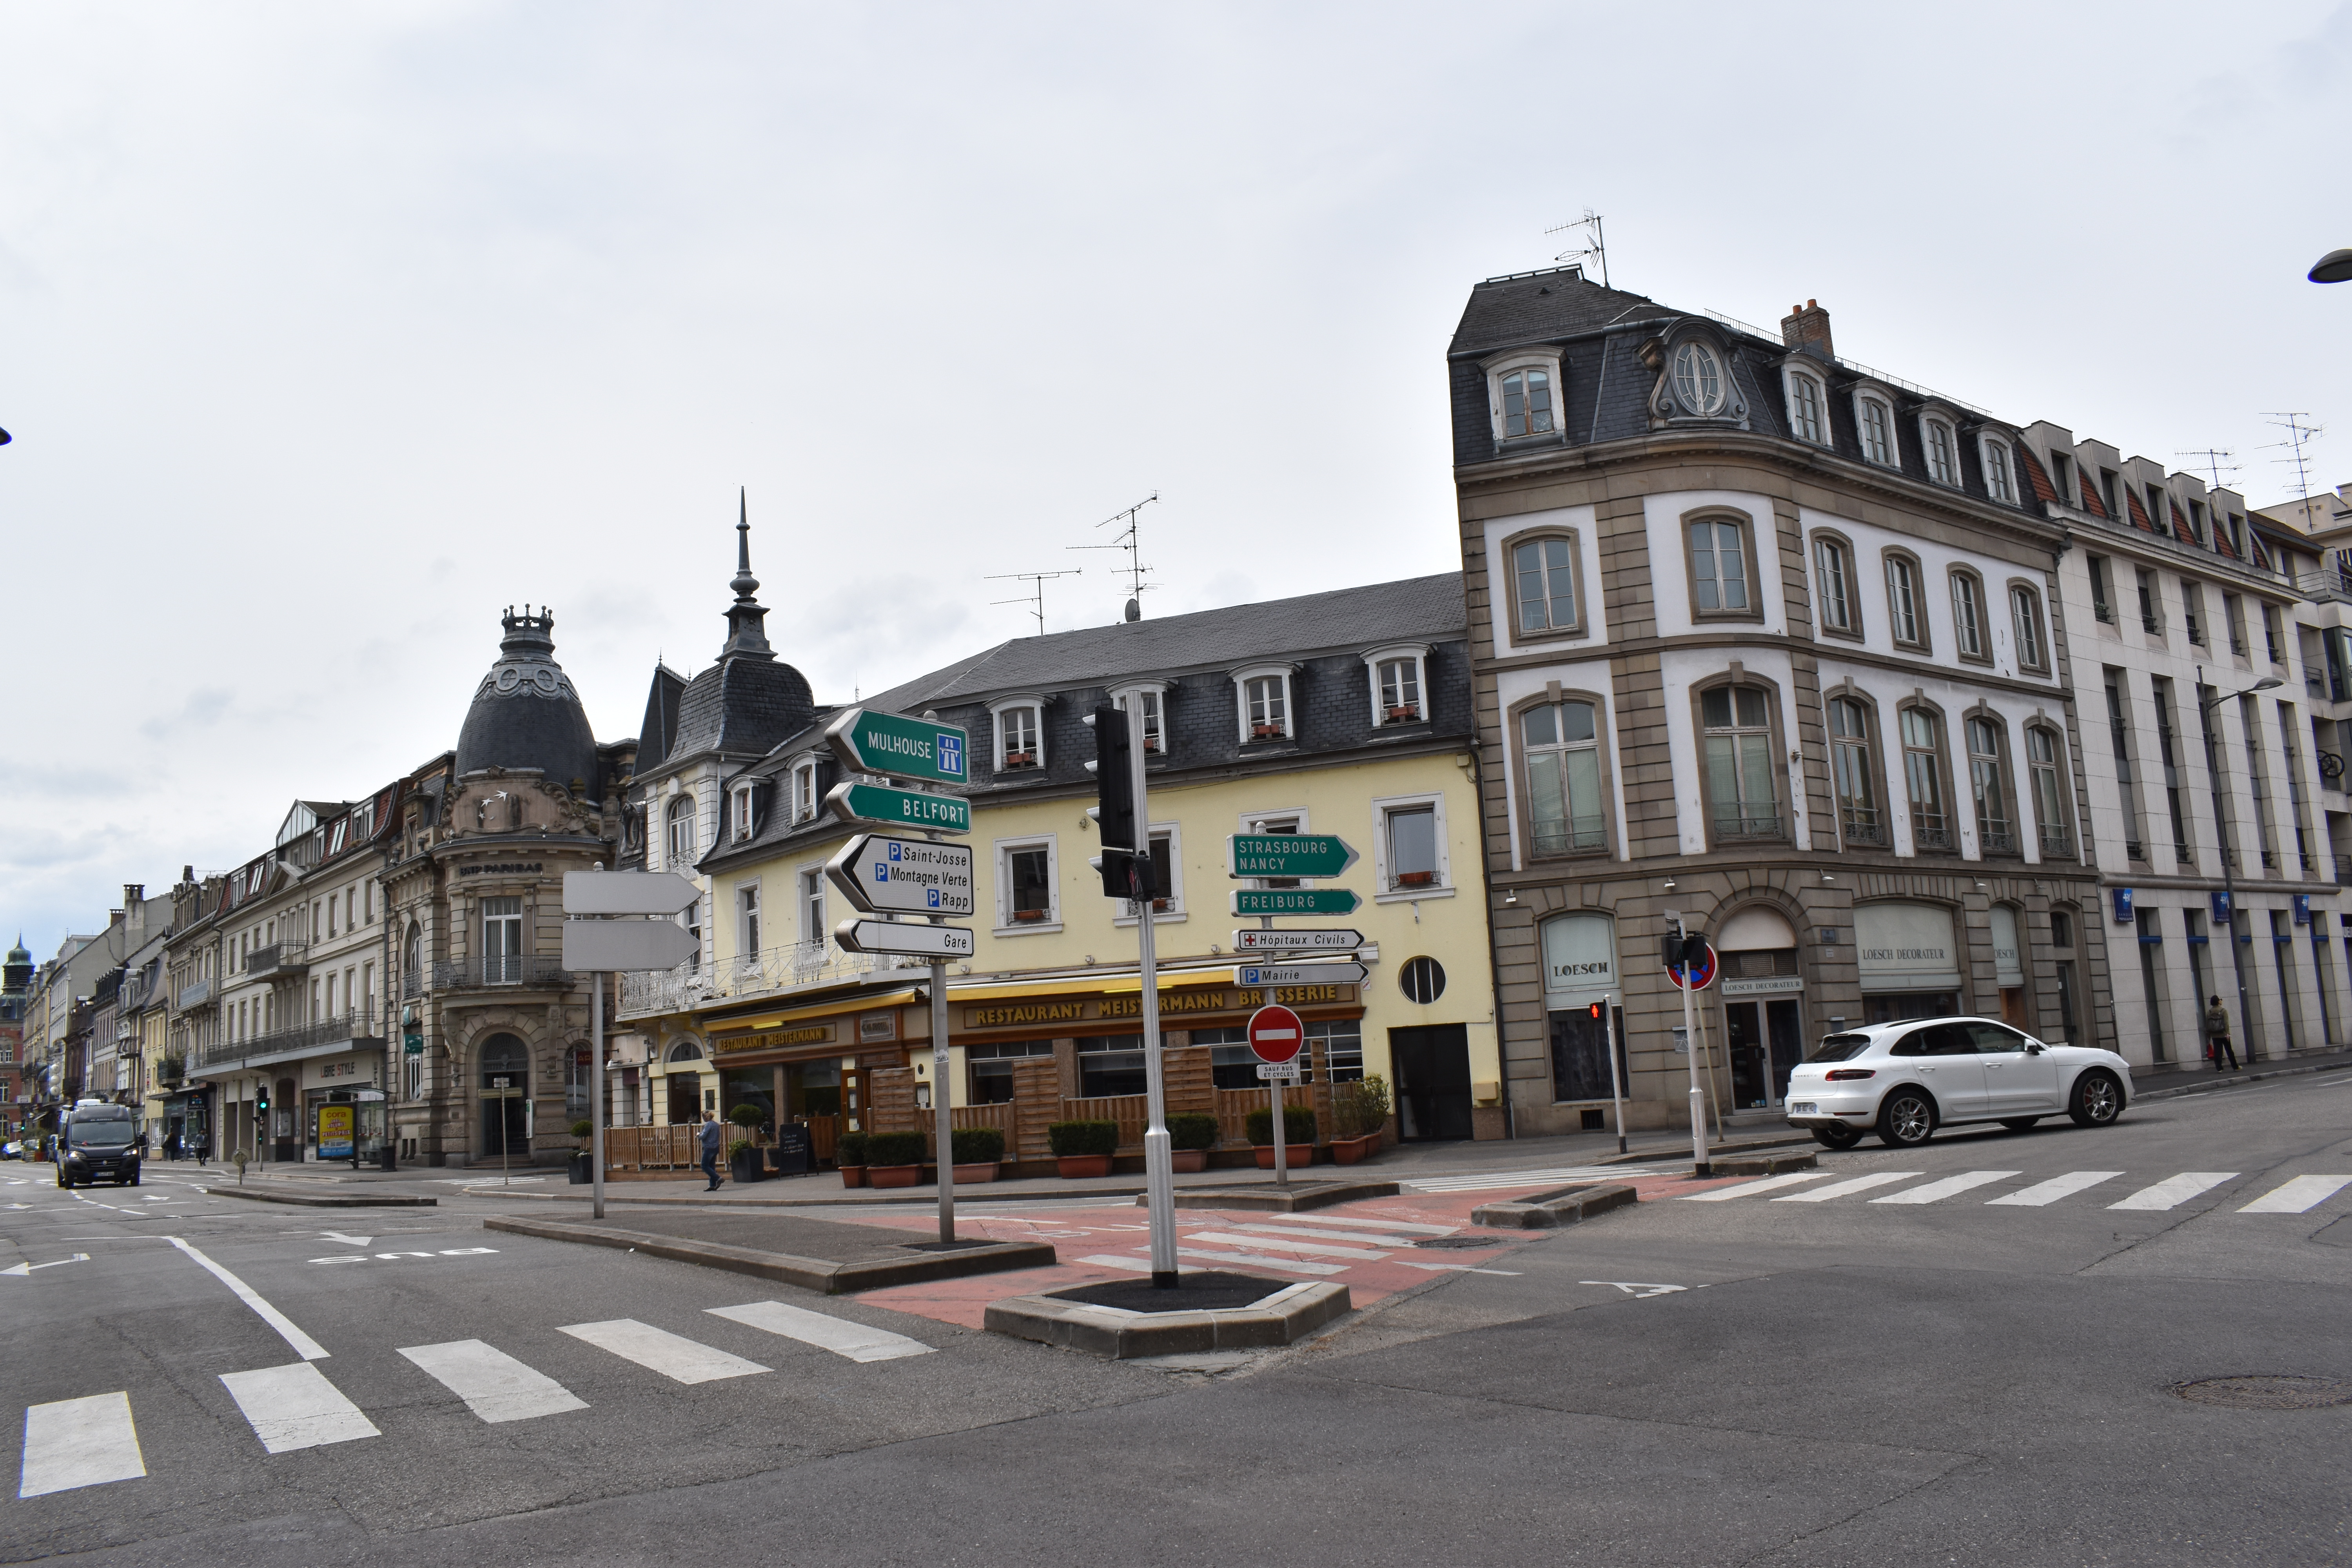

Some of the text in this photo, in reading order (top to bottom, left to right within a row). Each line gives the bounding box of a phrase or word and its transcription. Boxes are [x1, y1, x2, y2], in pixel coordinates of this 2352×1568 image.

[868, 731, 931, 759] MULHOUSE
[903, 799, 964, 823] BELFORT
[1240, 841, 1327, 853] STRASBOURG
[904, 847, 967, 867] Saint-Josse
[1240, 858, 1285, 870] NANCY
[459, 863, 543, 875] BNP PARIBAS
[891, 866, 939, 886] Montagne
[942, 871, 967, 887] Verte
[942, 892, 968, 910] Rapp
[1242, 896, 1315, 908] FREIBURG
[944, 934, 967, 949] Gare
[1315, 935, 1345, 944] Civils
[1863, 949, 1945, 960] LOESCH DECORATEUR
[1994, 949, 2014, 959] OESCH
[1262, 970, 1299, 980] Mairie
[1554, 962, 1608, 976] LOESCH
[976, 985, 1336, 1024] RESTAURANT MEISTRMANN BRSSERIE
[719, 1027, 822, 1051] RESTAURANT MEISTERMANN
[321, 1062, 354, 1078] LIBRE STYLE
